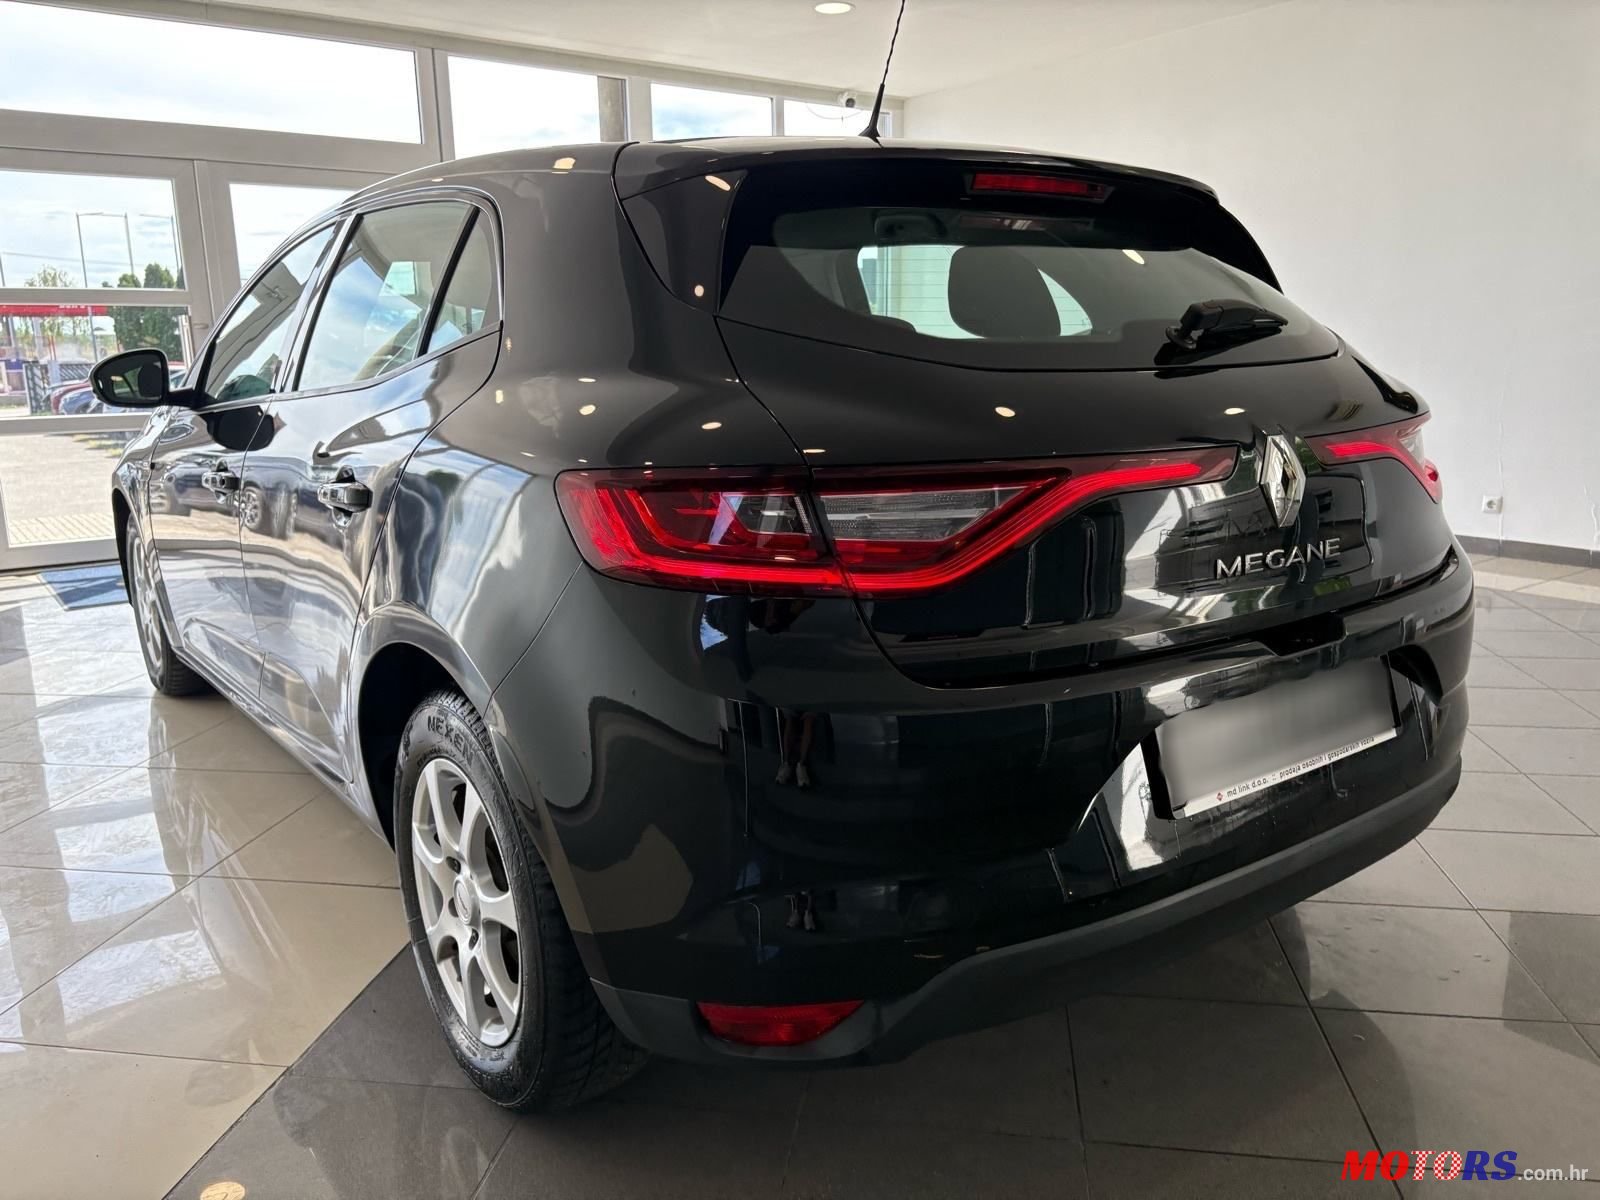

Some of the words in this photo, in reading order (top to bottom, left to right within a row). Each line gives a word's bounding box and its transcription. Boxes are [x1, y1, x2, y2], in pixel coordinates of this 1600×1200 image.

[1216, 538, 1340, 579] MEGANE
[428, 716, 473, 768] NEXEN
[1238, 783, 1251, 793] link
[1251, 777, 1269, 788] d.o.o.
[1280, 765, 1301, 779] prodaja
